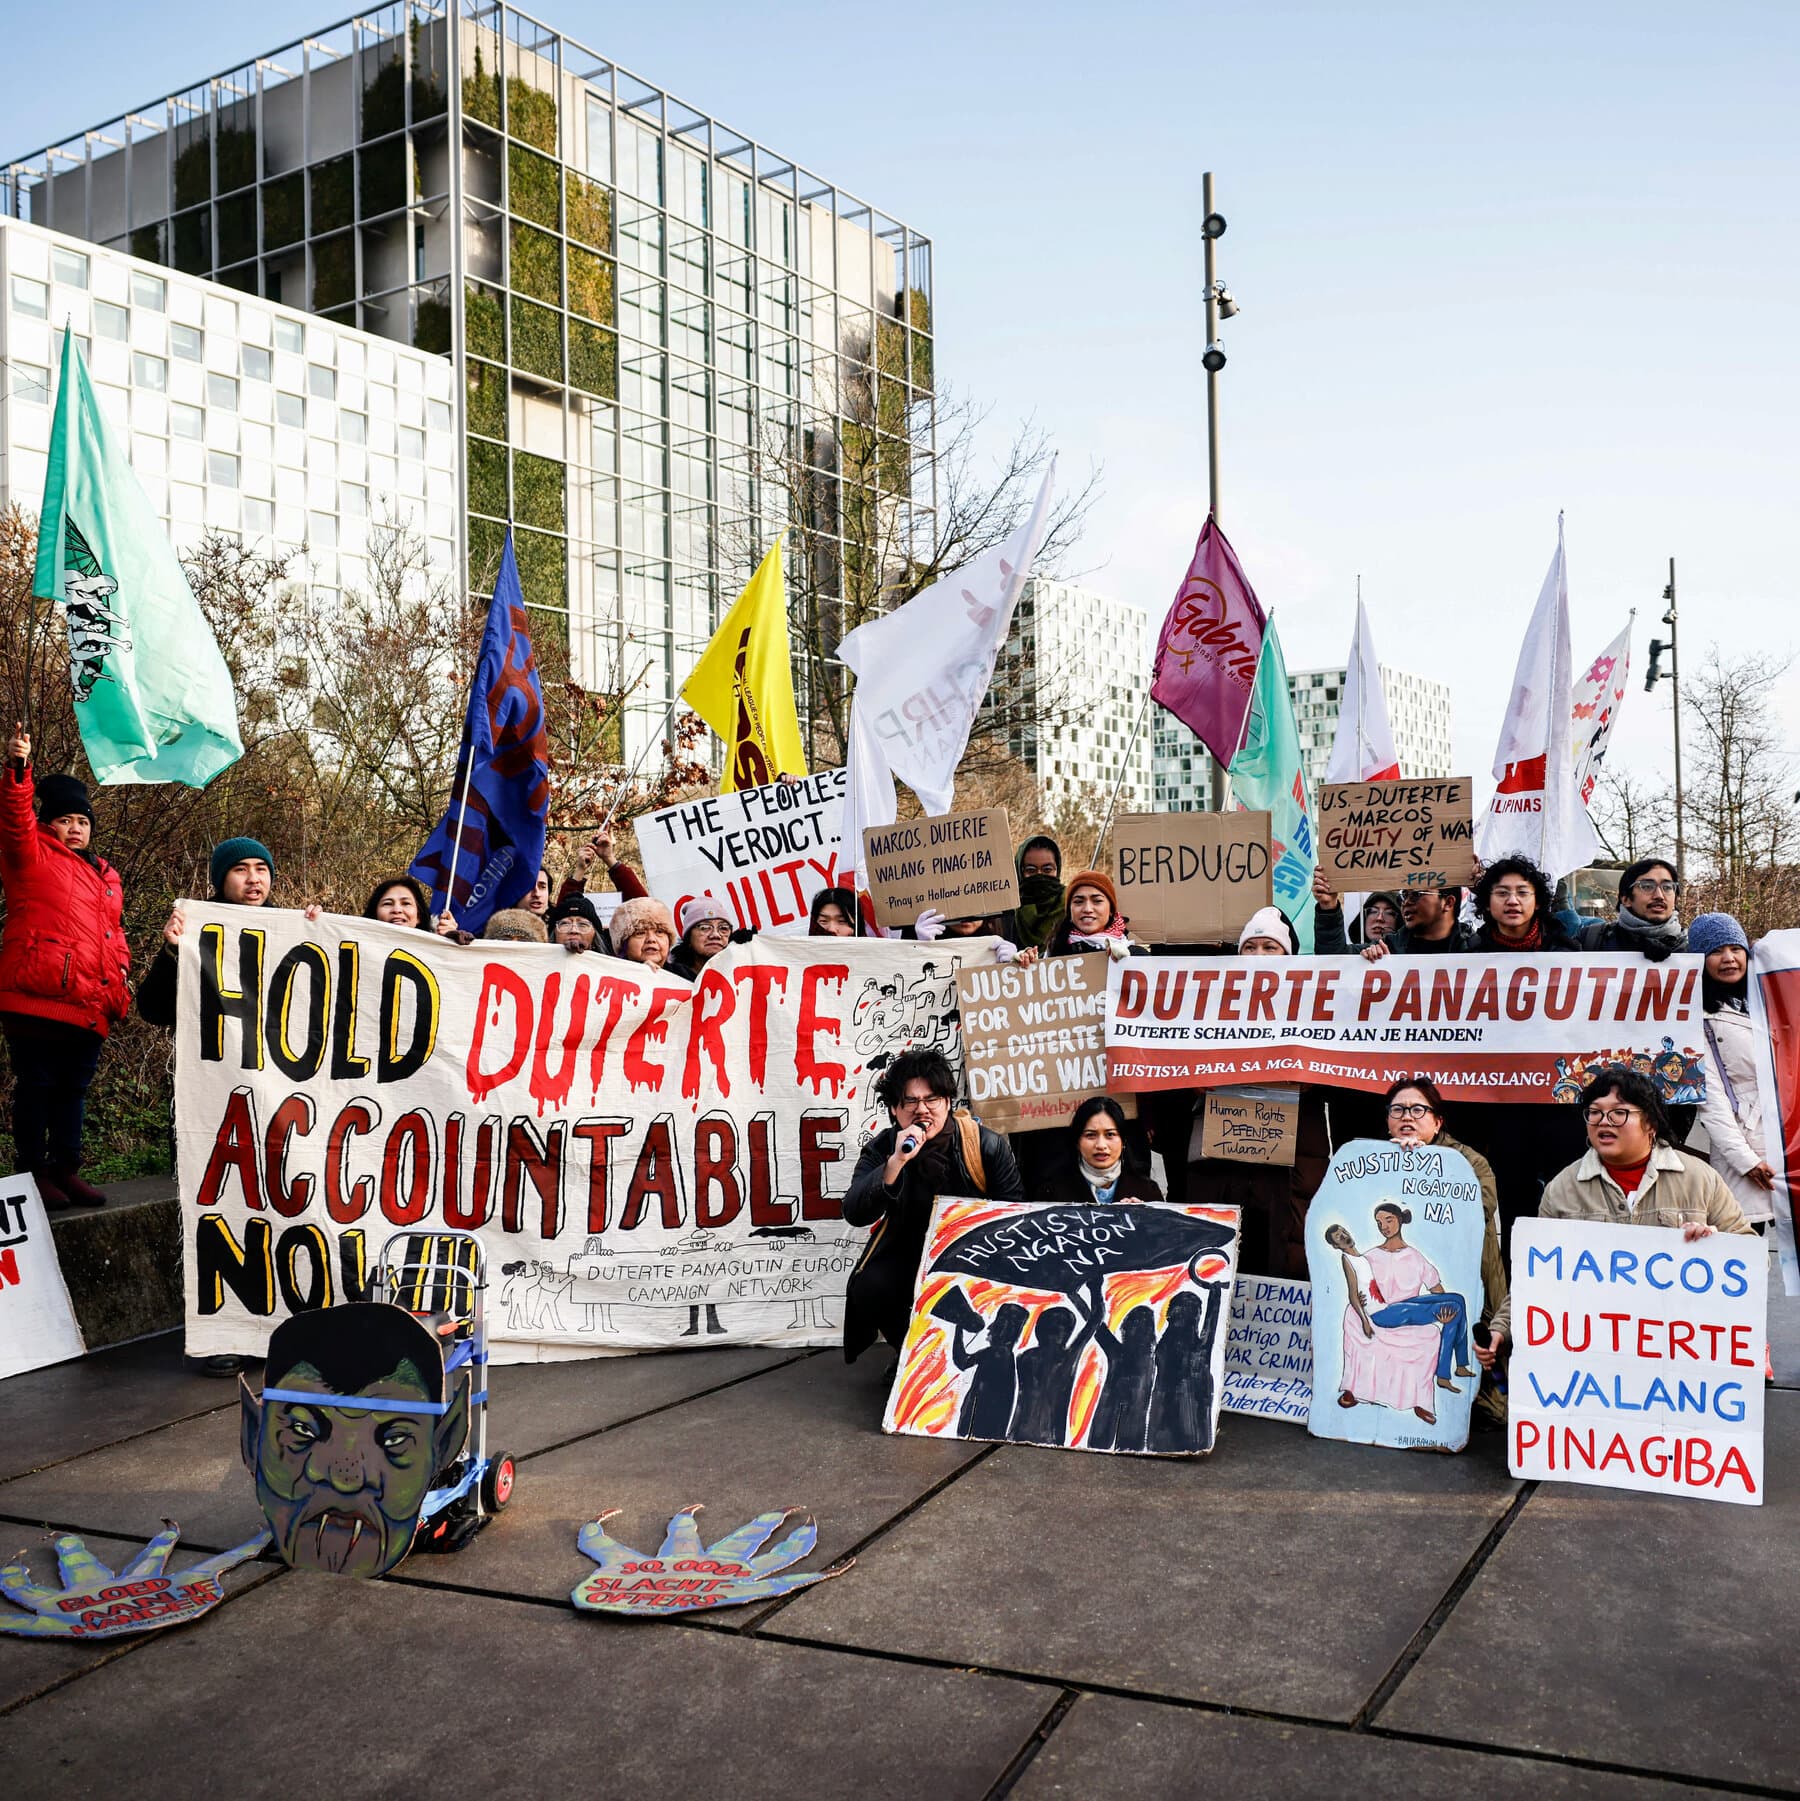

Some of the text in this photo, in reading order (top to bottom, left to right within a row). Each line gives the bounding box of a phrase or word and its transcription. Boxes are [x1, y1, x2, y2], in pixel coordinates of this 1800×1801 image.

[744, 686, 757, 713] LEAGUE
[655, 799, 724, 844] THE
[930, 816, 988, 845] DUTERTE
[1325, 826, 1402, 849] GUILTY
[1413, 825, 1434, 842] OF
[1119, 842, 1269, 886] BERDUGO
[1334, 842, 1434, 869] CRIMES!
[875, 859, 925, 883] WALANG
[961, 957, 1087, 1003] JUSTICE
[1115, 966, 1699, 1022] DUTERTE PANAGUTIN!
[199, 923, 850, 1117] HOLD DUTERTE
[965, 1006, 1010, 1034] FOR
[1114, 1024, 1483, 1043] DUTERTE SCHANDE, BLOED AAN JE HANDEN!
[970, 1039, 998, 1060] OF
[968, 1059, 1048, 1101] DRUG
[1112, 1063, 1191, 1078] HUSTISYA
[1194, 1062, 1236, 1076] PARA
[1241, 1061, 1262, 1073] SA
[1265, 1057, 1304, 1071] MGA
[1308, 1060, 1378, 1082] BIKTIMA
[1210, 1099, 1286, 1126] Human Rights
[1222, 1119, 1284, 1140] DEFENDER
[197, 1085, 850, 1241] ACCOUNTABLE
[1334, 1151, 1443, 1183] HUSTISYA
[1402, 1178, 1478, 1201] NGAYON
[1424, 1203, 1455, 1225] NA
[956, 1210, 1114, 1267] HUSTISYA
[1007, 1213, 1137, 1272] NGAYON
[587, 1257, 856, 1281] DUTERTE PANAGUTIN EUROP
[1063, 1247, 1124, 1275] NA
[1528, 1246, 1748, 1297] MARCOS
[628, 1276, 814, 1302] CAMPAIGN NETWORK
[1235, 1280, 1247, 1298] E
[1252, 1304, 1311, 1327] ACCOUN
[1228, 1324, 1280, 1351] odrigo
[1527, 1305, 1755, 1367] DUTERTE
[1528, 1370, 1746, 1423] WALANG
[57, 1578, 172, 1612] BLOED
[81, 1592, 177, 1624] AAN
[177, 1578, 217, 1598] JE
